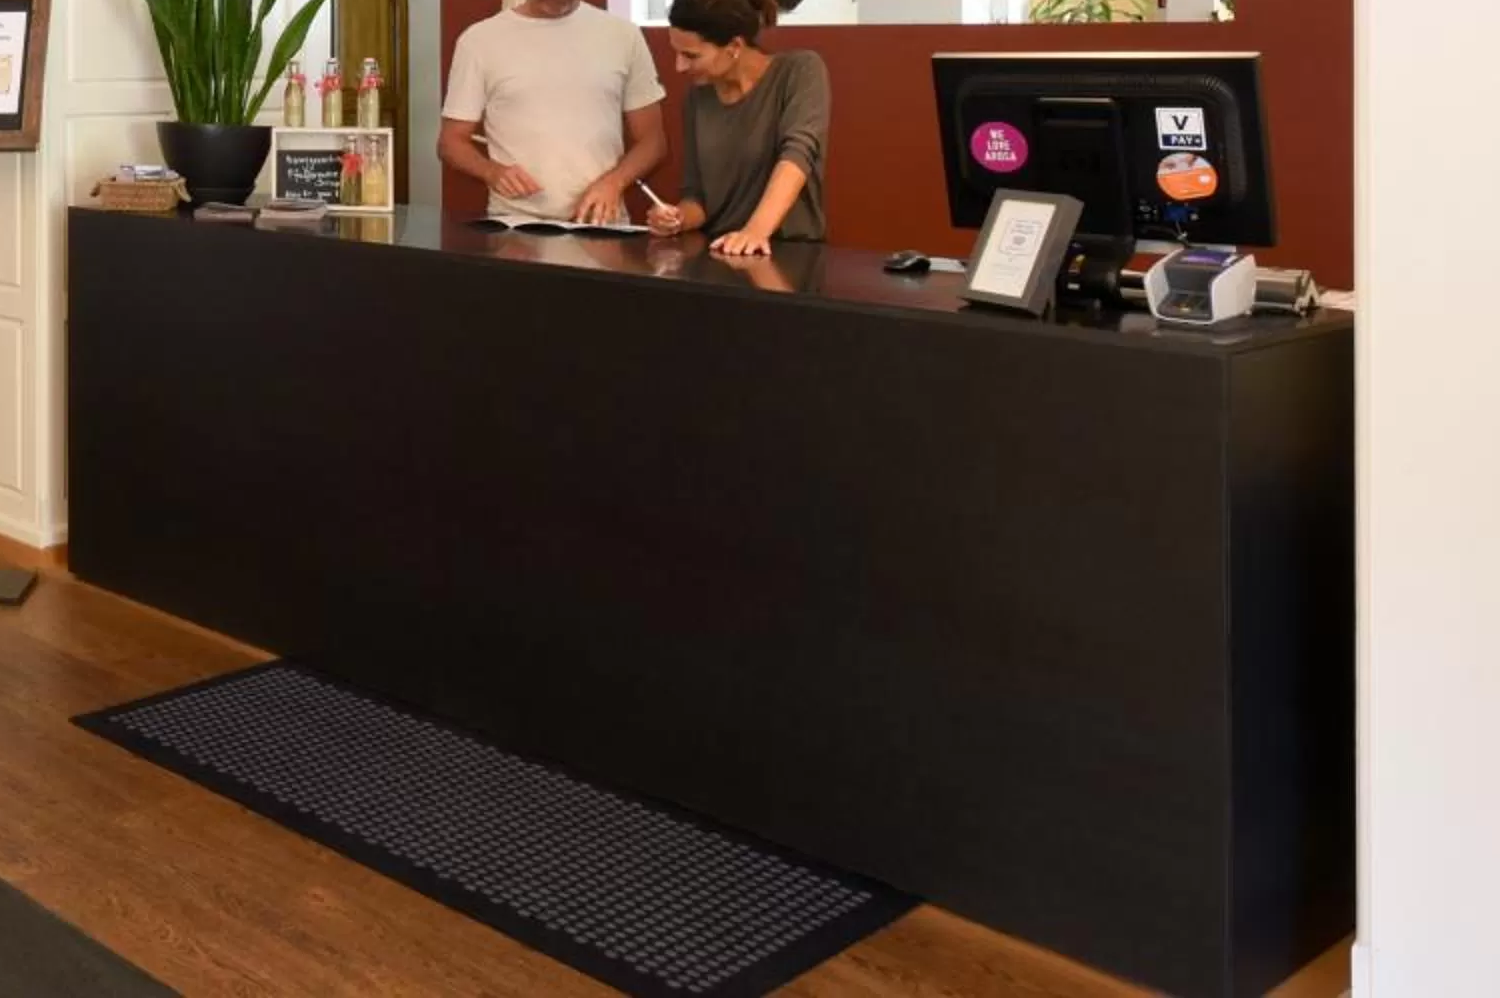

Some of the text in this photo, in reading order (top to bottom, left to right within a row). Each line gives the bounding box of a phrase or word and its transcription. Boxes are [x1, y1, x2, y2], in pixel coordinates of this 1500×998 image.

[1171, 115, 1189, 131] V
[989, 128, 1005, 140] WE
[987, 140, 1011, 151] LOVE
[1171, 135, 1193, 145] PAY
